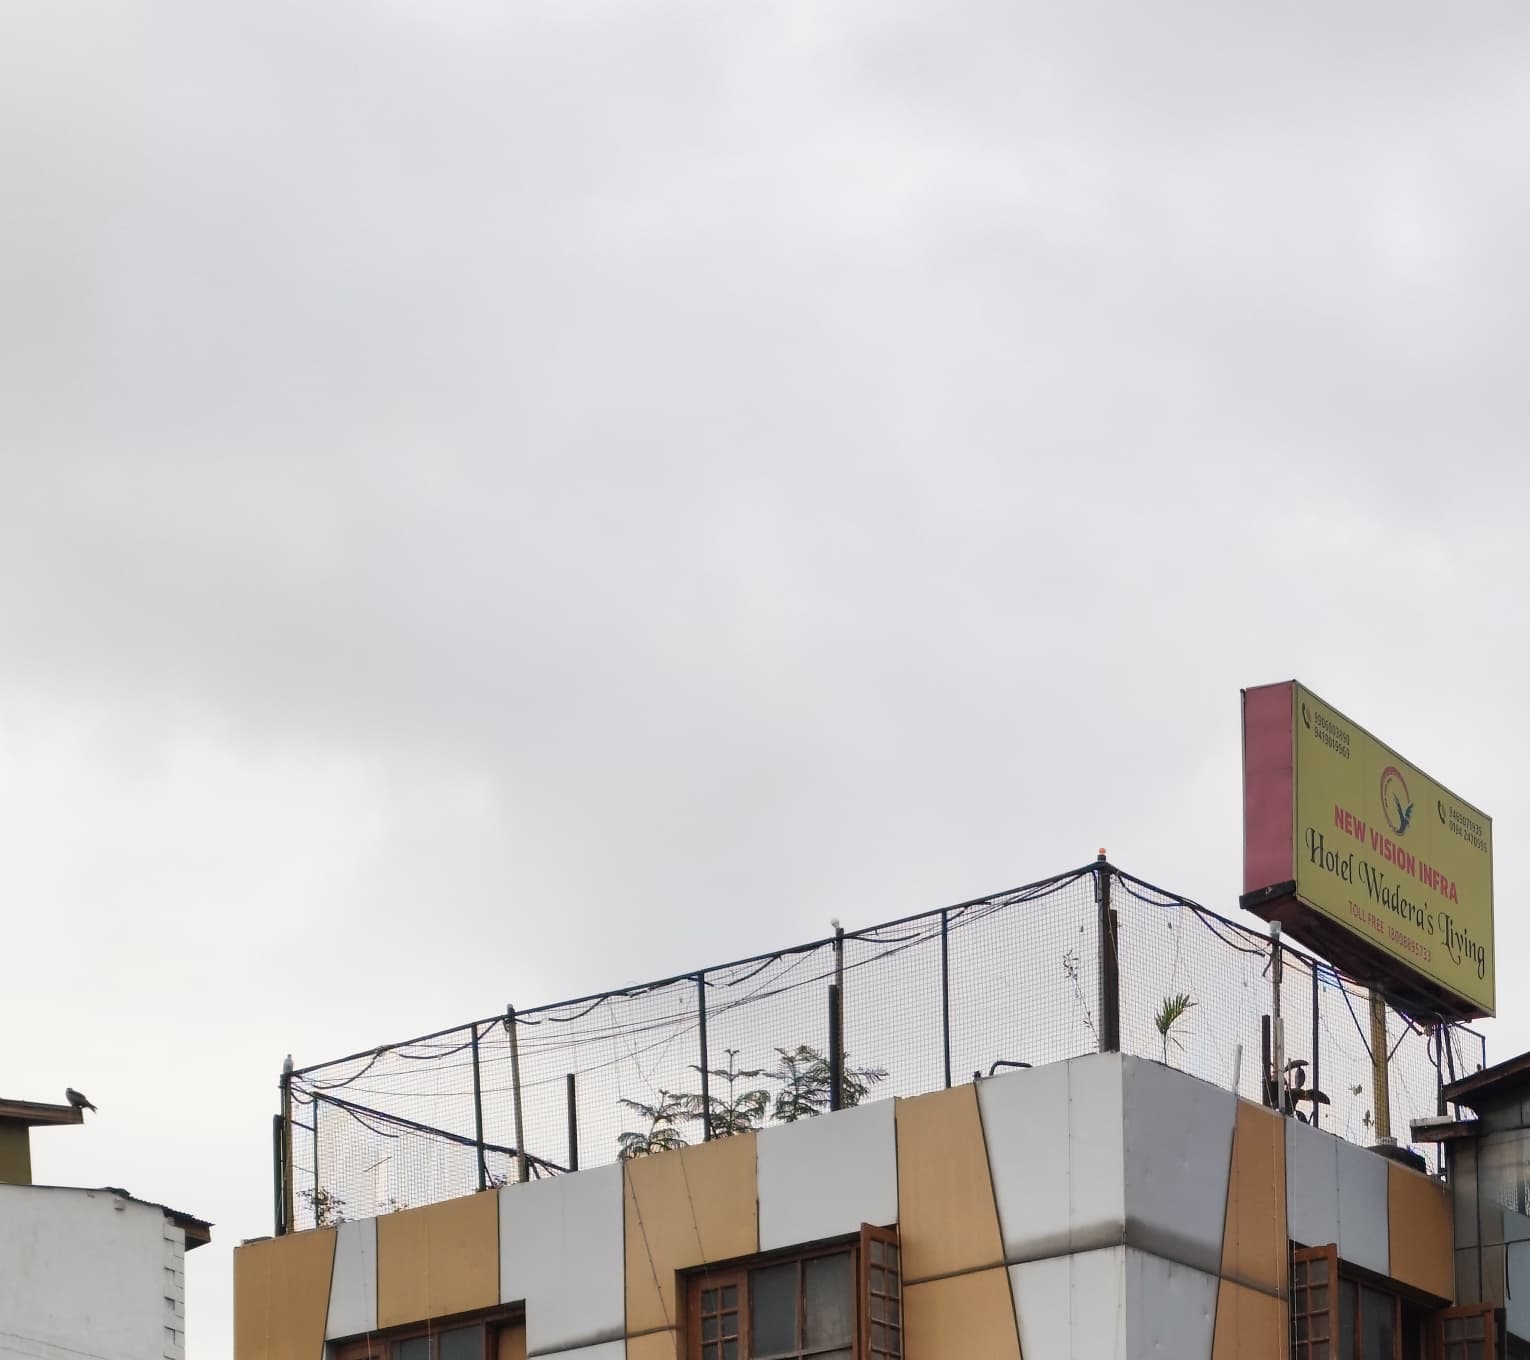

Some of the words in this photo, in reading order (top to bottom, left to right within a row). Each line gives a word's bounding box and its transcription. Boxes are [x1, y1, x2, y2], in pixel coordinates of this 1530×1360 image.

[1305, 827, 1354, 885] Hotel
[1358, 858, 1435, 936] Wadera's
[1334, 803, 1366, 844] NEW
[1369, 826, 1416, 878] VISION
[1419, 859, 1459, 905] INFRA
[1347, 900, 1366, 923] TOLL
[1367, 912, 1384, 935] FREE
